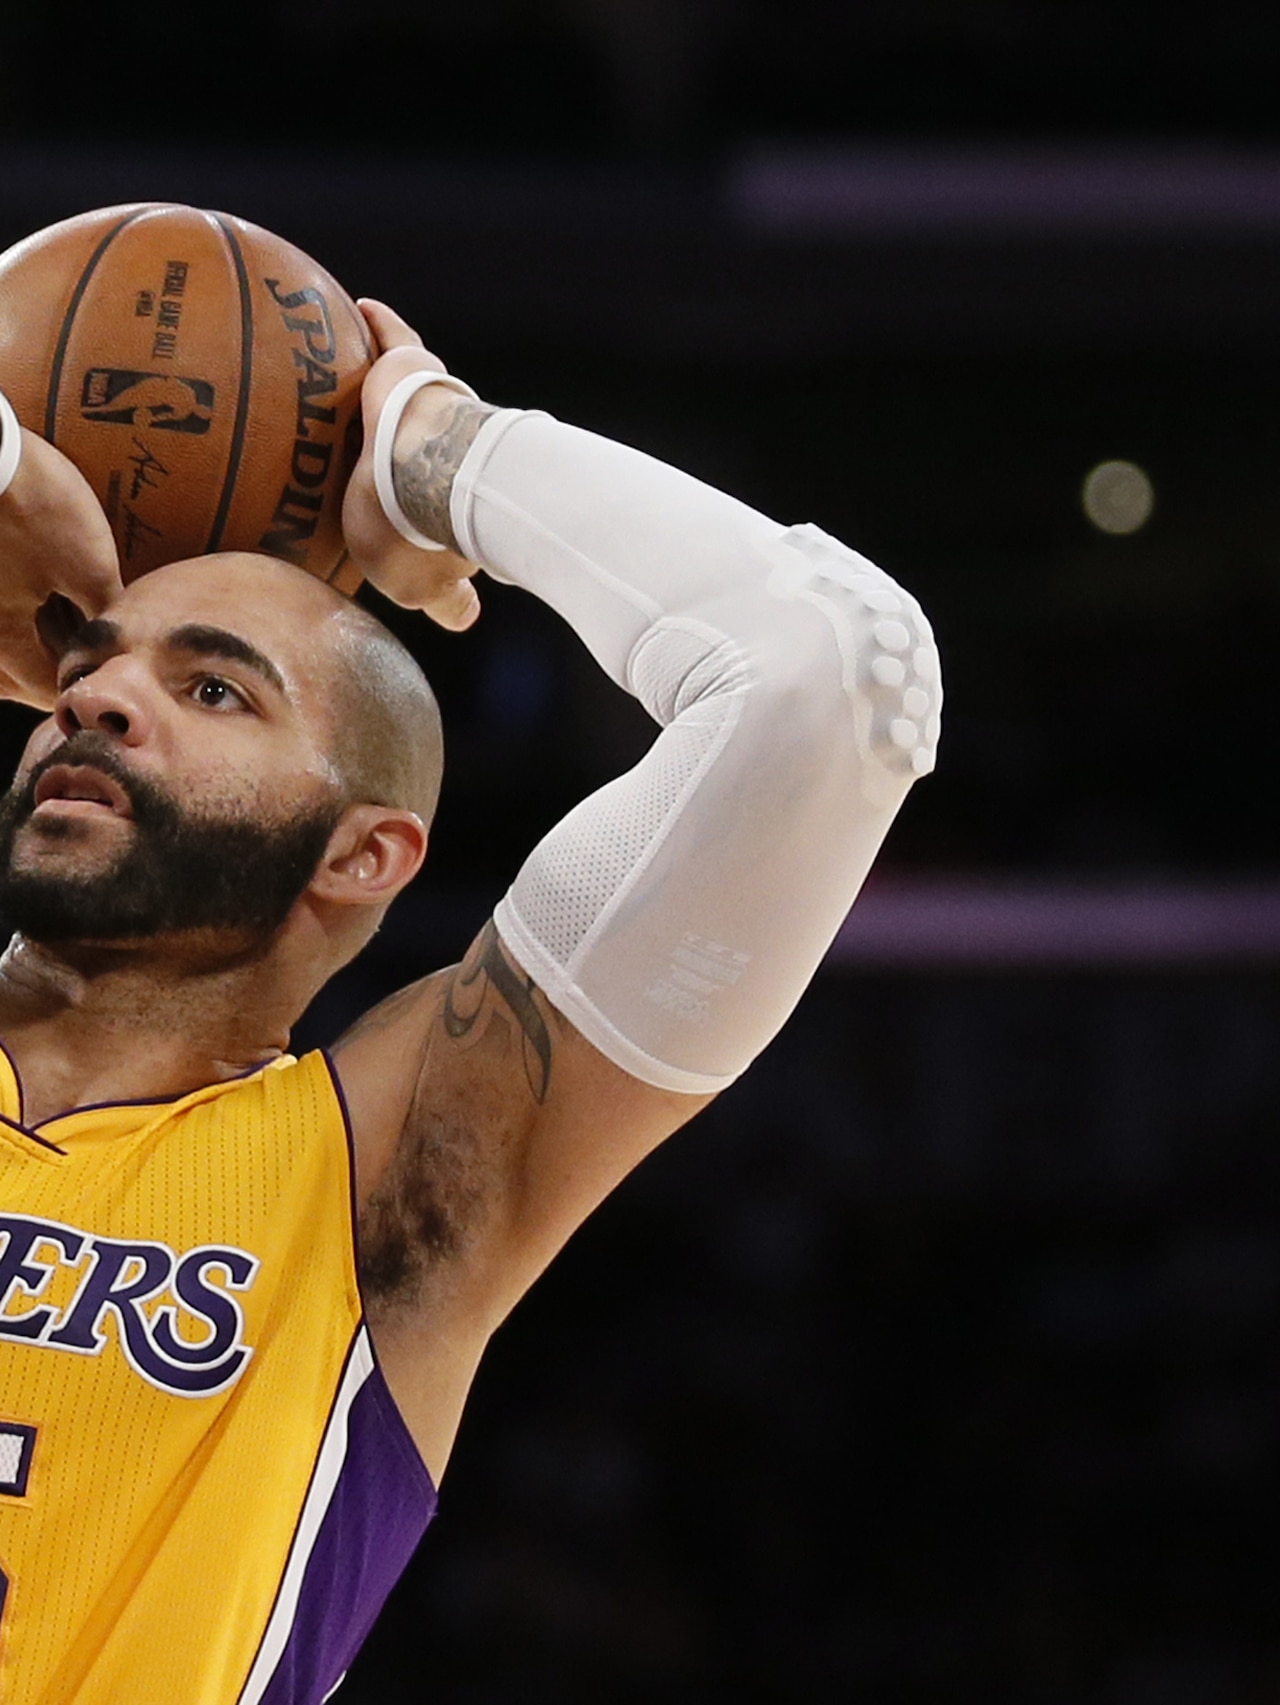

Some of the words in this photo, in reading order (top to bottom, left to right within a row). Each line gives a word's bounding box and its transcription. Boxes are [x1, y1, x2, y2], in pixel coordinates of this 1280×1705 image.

[157, 301, 181, 329] GAME
[152, 332, 176, 360] BALL
[259, 278, 337, 560] SPALDIN
